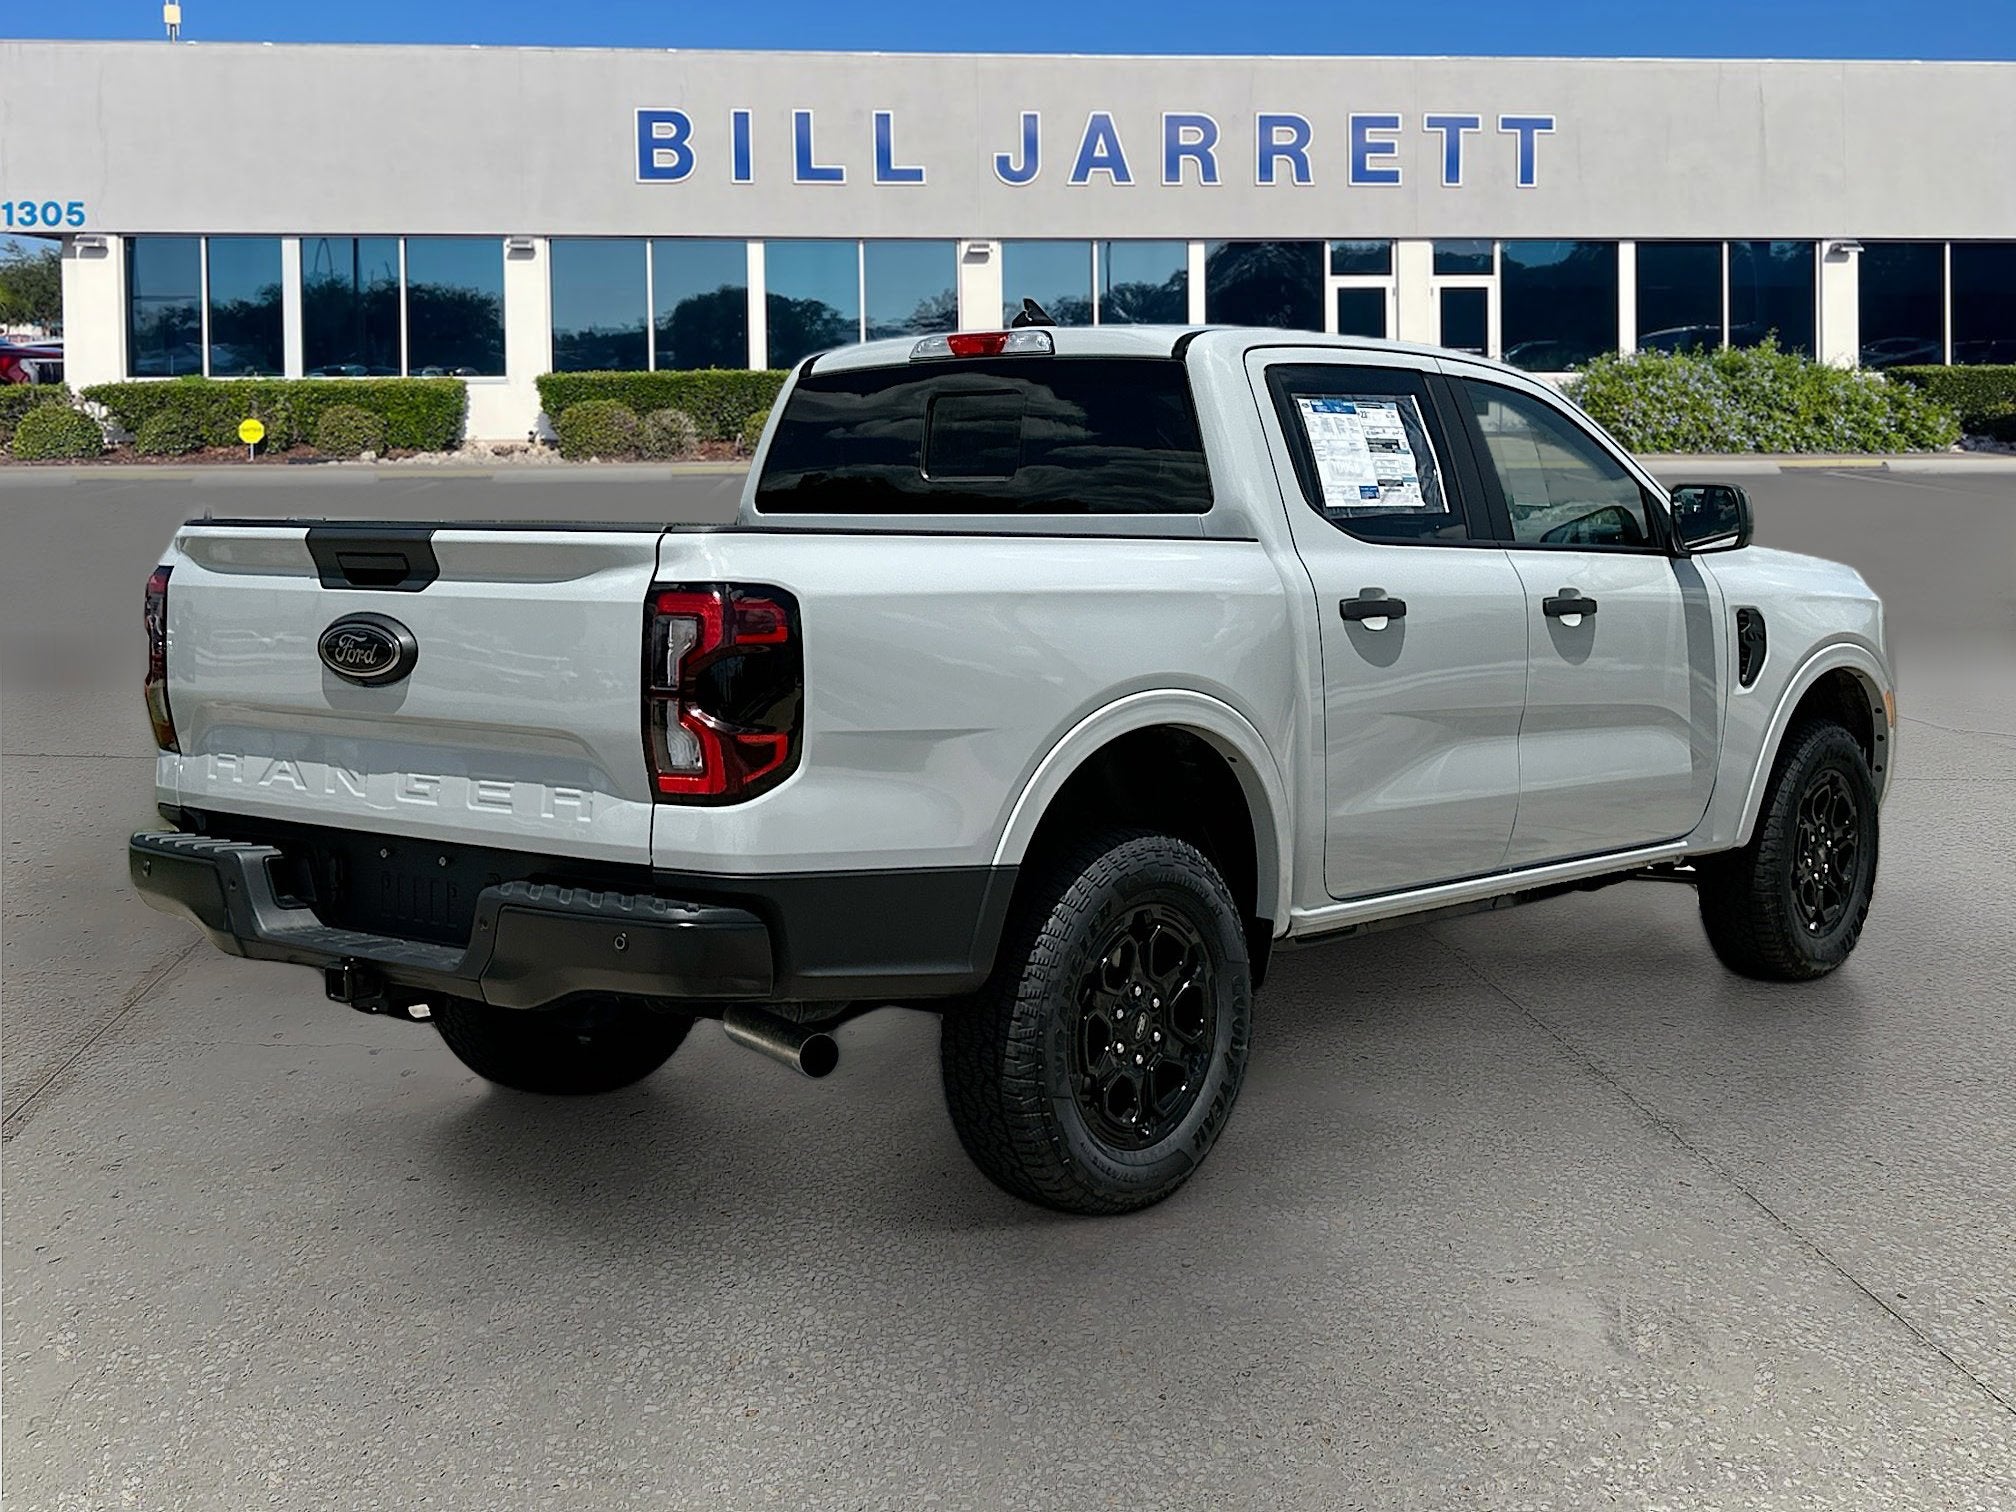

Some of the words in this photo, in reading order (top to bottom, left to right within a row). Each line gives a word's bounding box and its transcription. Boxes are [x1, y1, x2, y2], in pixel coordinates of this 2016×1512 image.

[634, 107, 926, 185] BILL
[993, 109, 1556, 188] JARRETT
[1, 200, 86, 227] 1305
[335, 633, 378, 665] Ford
[206, 747, 594, 822] RANGER
[1191, 974, 1248, 1151] GOODYEAR
